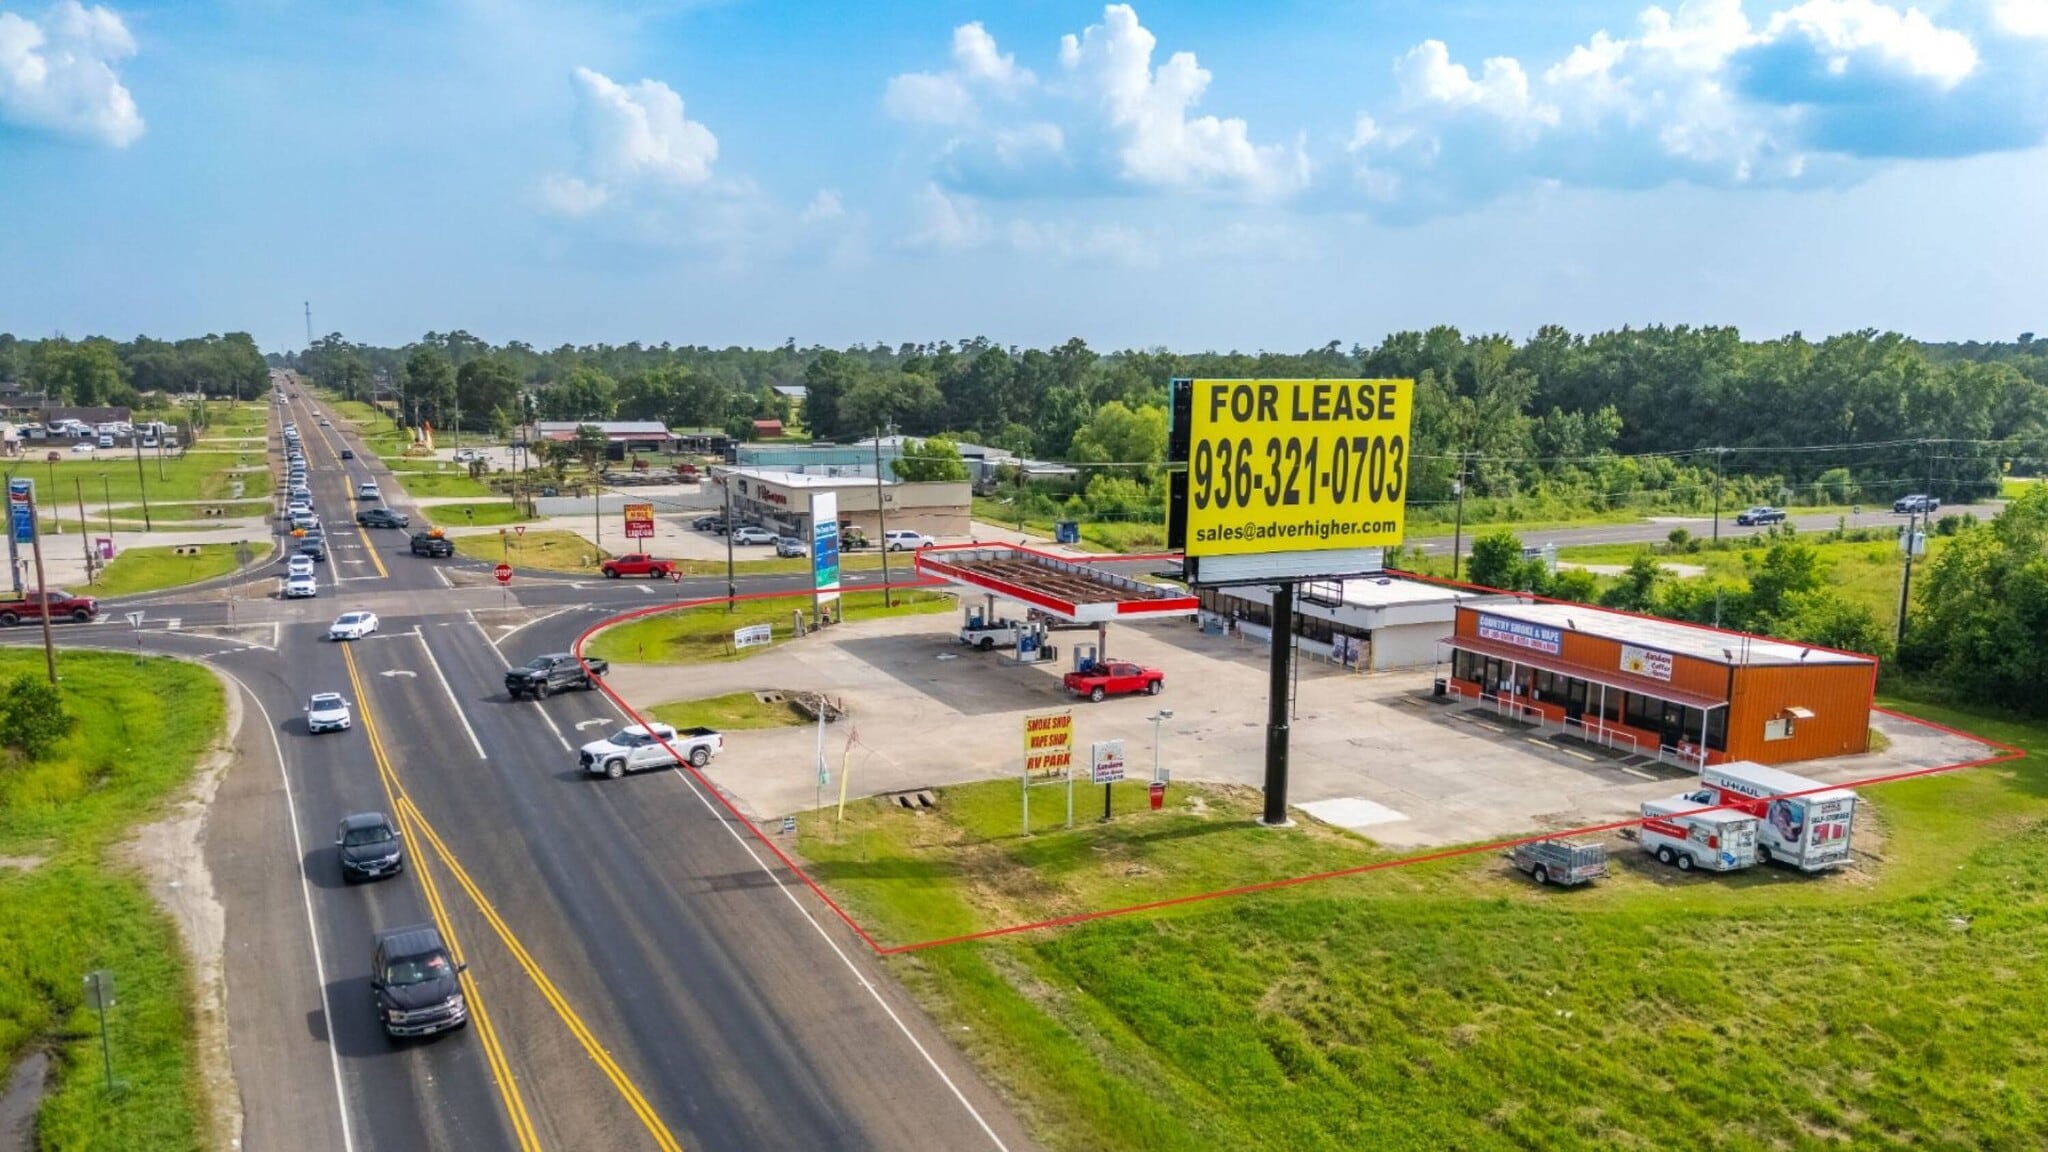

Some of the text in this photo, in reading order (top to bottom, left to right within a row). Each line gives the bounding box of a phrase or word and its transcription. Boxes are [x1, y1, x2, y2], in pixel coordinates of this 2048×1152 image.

[1210, 384, 1397, 423] FOR LEASE
[1194, 435, 1404, 510] 936-321-0703
[1196, 519, 1396, 542] sales@adverhigher.com
[495, 569, 511, 577] STOP
[1480, 614, 1509, 632] COUNTRY
[1510, 622, 1534, 637] SMOKE
[1541, 629, 1559, 642] VAPE
[1027, 715, 1072, 732] SMOKE SHOP
[1031, 732, 1068, 748] VAPE SHOP
[1027, 753, 1071, 770] RV PARK
[1721, 778, 1760, 798] U-HAUL
